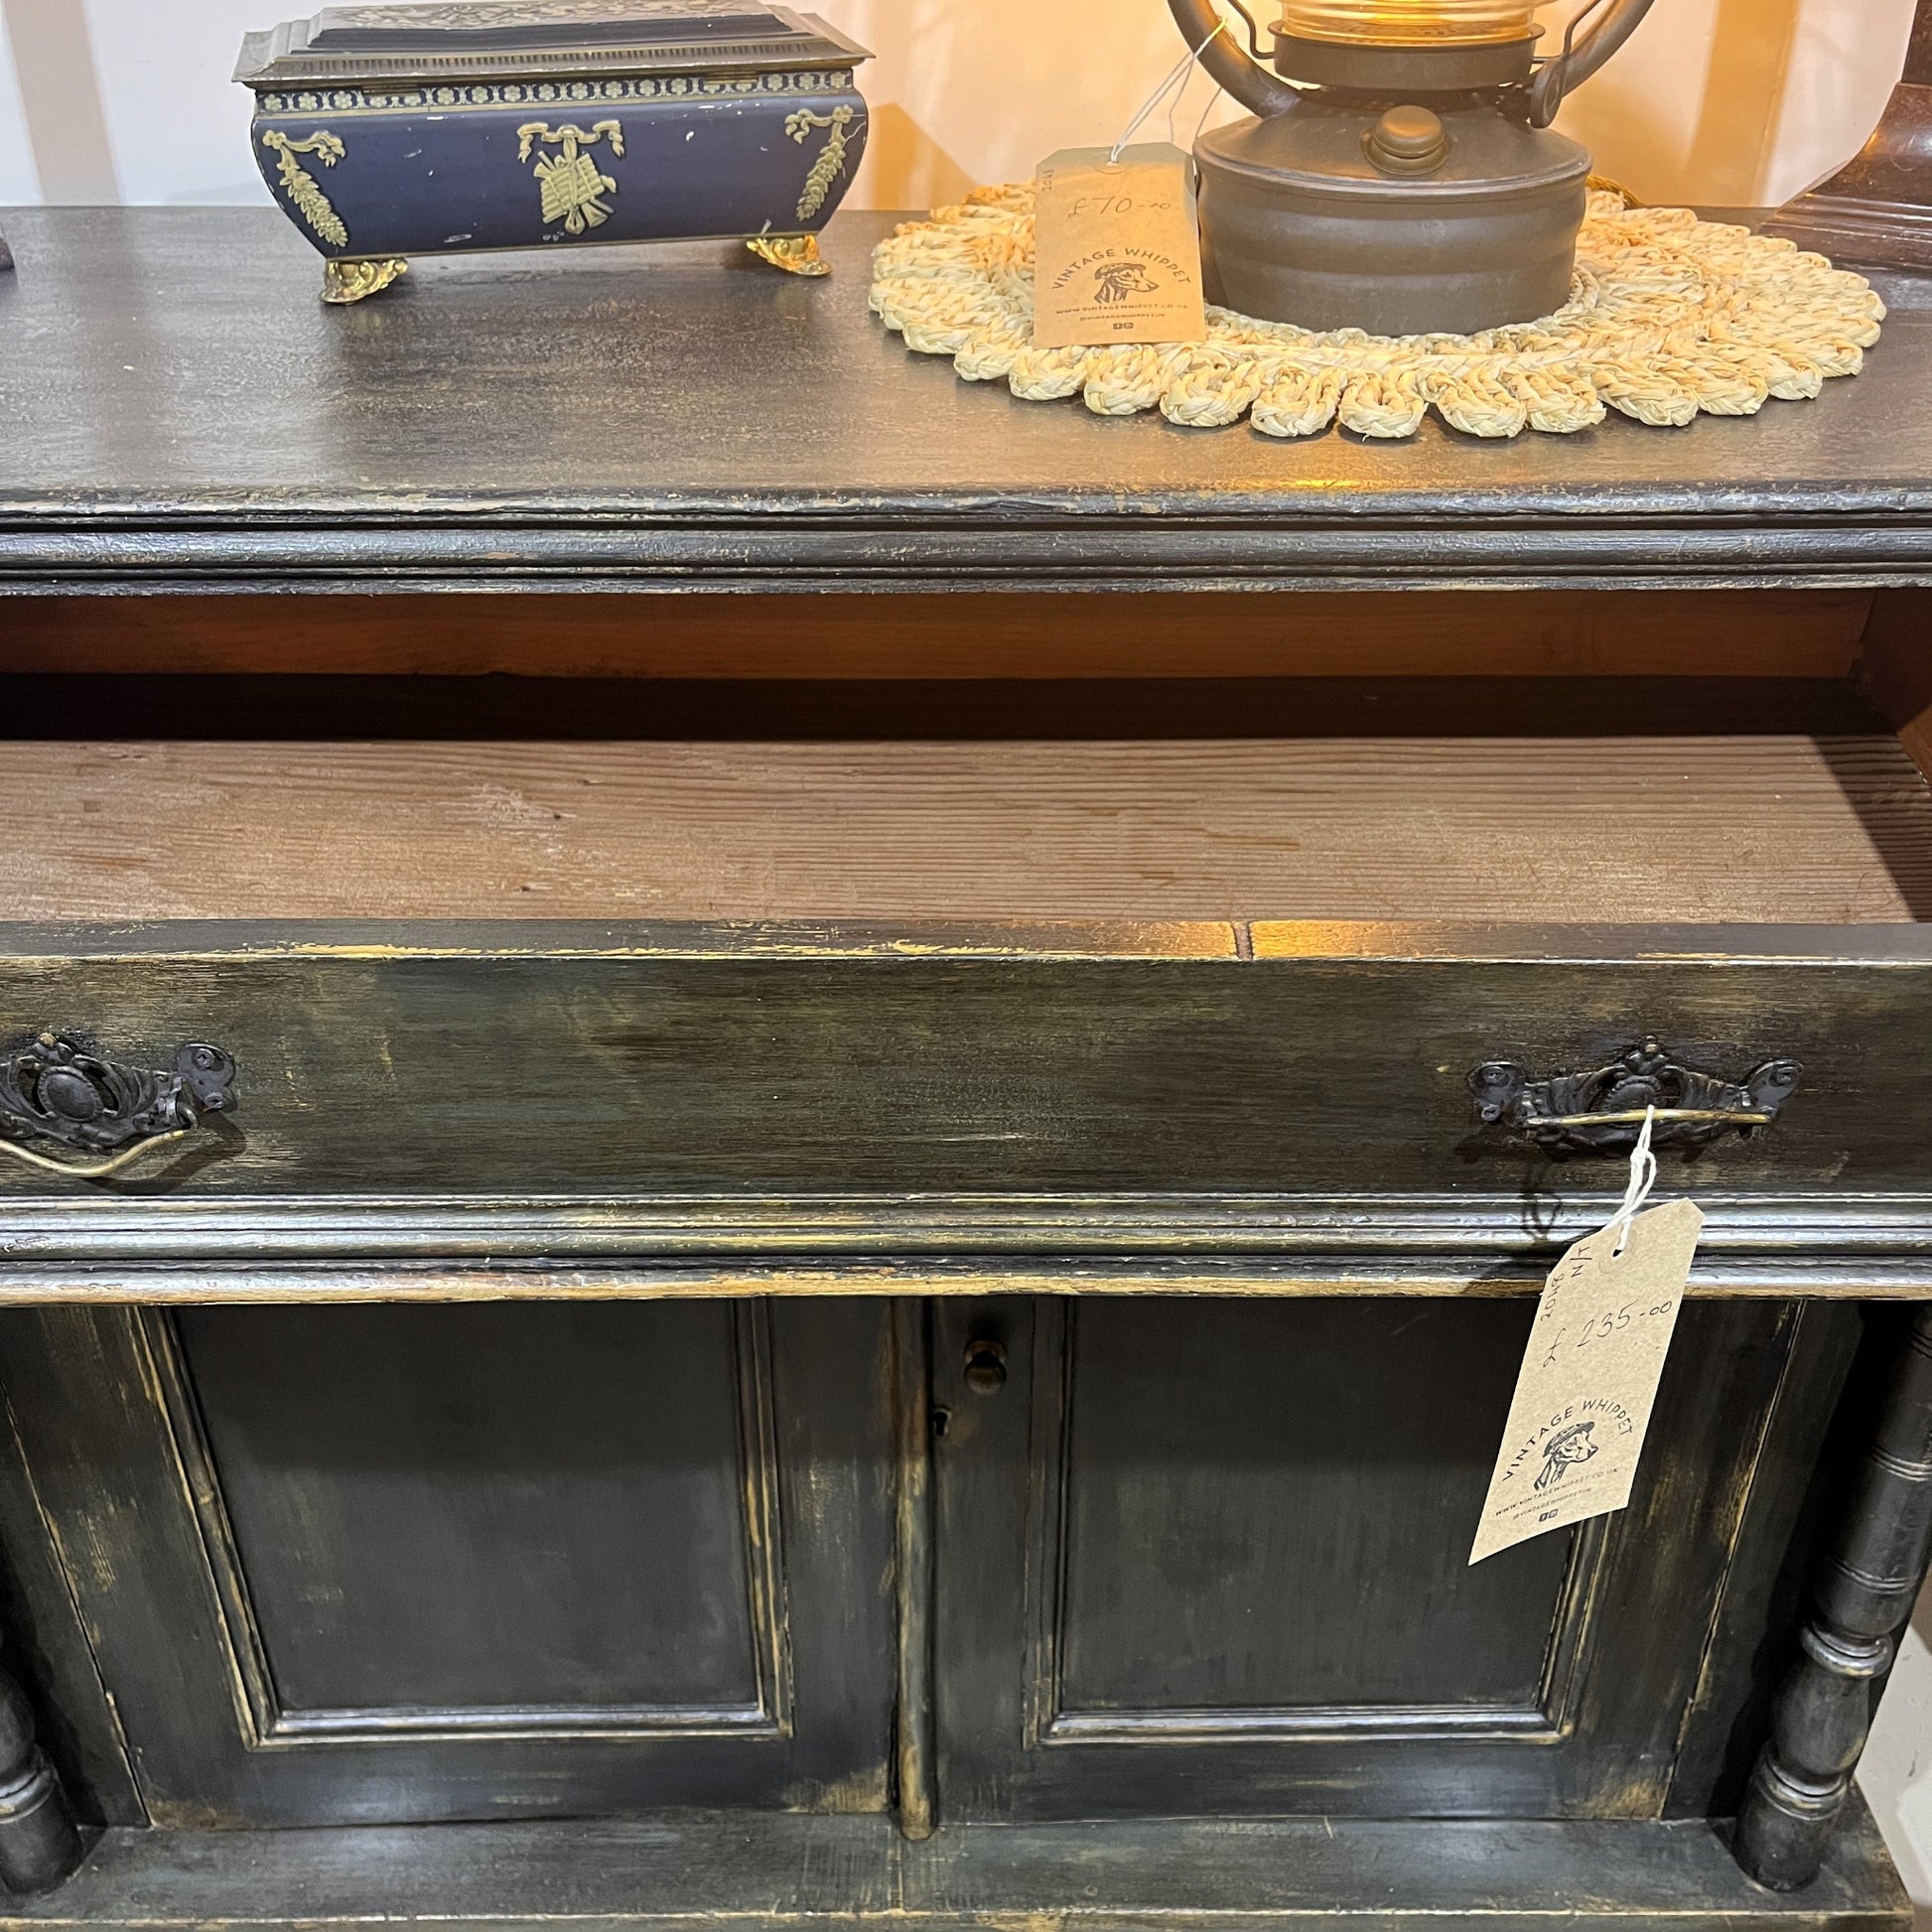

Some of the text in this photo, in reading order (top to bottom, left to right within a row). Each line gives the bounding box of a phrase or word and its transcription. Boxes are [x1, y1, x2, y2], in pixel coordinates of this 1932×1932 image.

[1051, 247, 1191, 290] VINTAGE WHIPPET
[1501, 1398, 1633, 1482] VINTAGE WHIPPET
